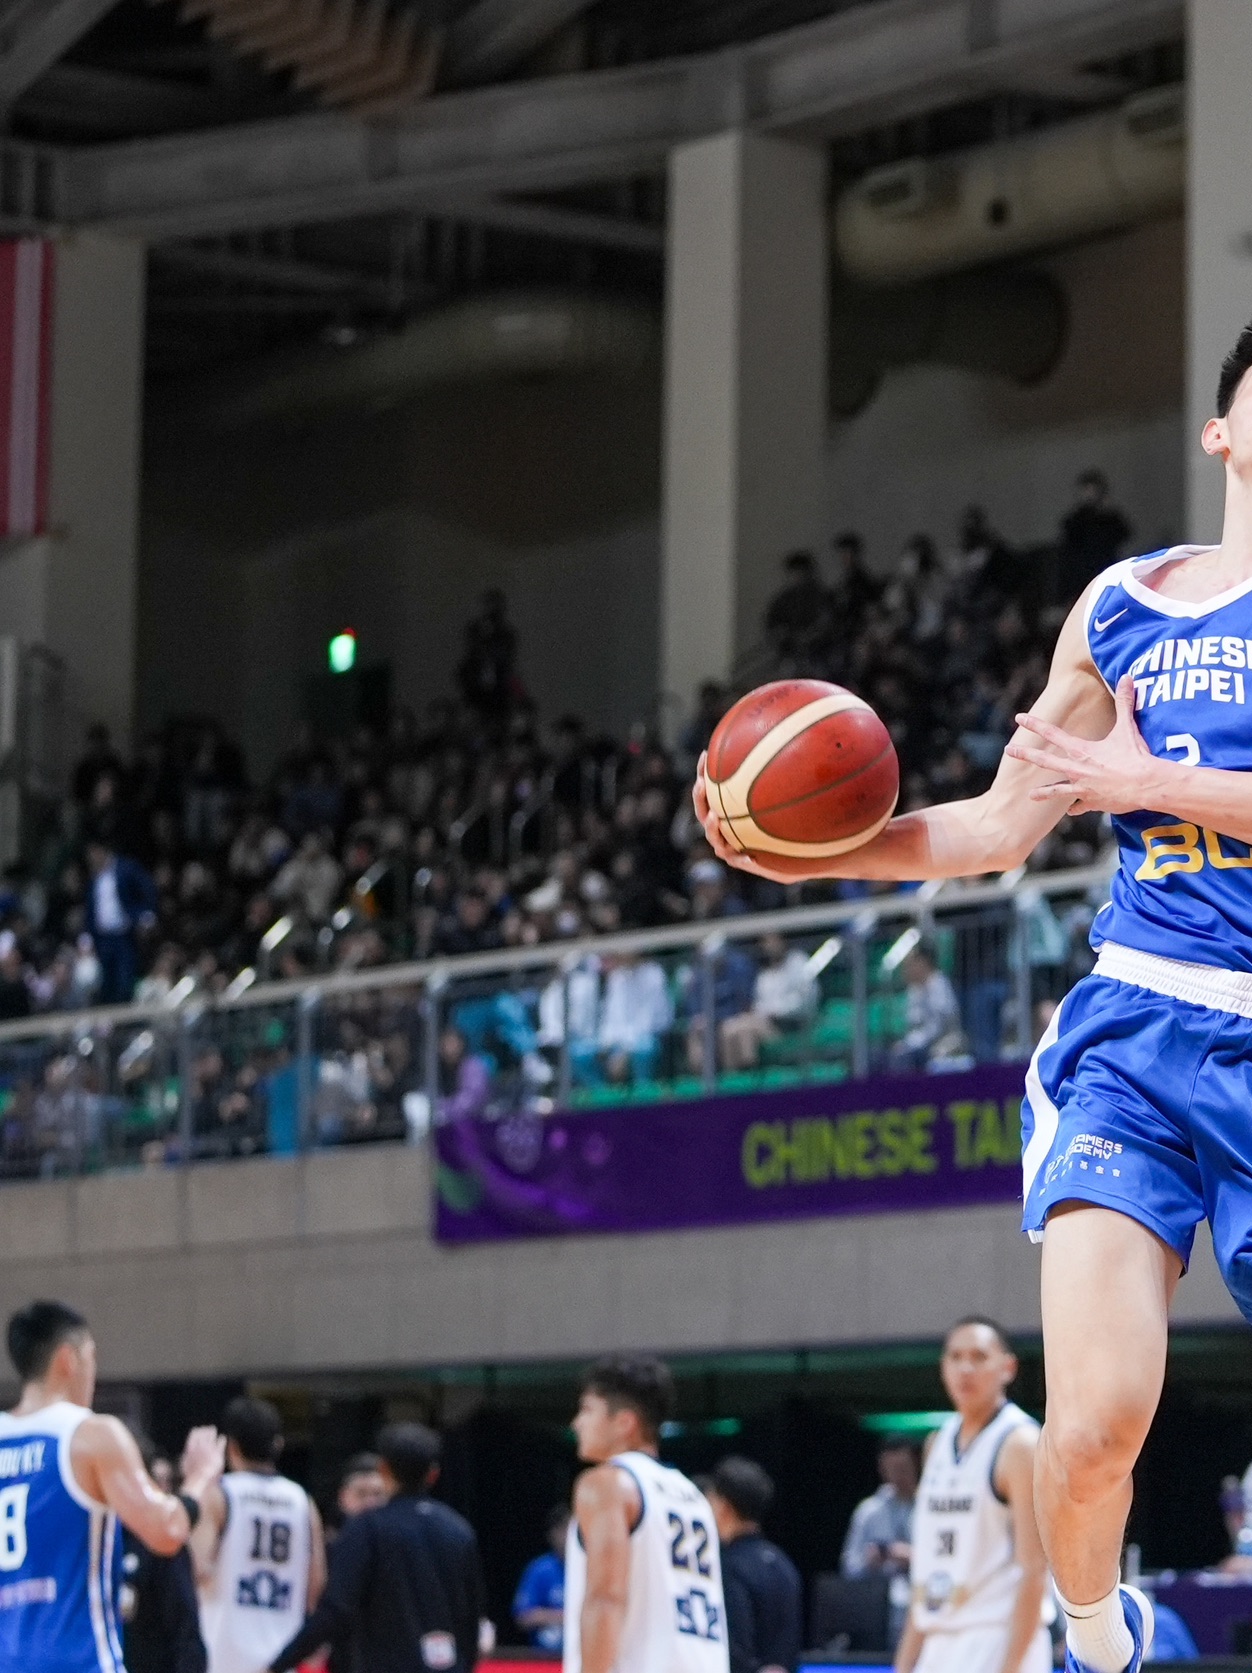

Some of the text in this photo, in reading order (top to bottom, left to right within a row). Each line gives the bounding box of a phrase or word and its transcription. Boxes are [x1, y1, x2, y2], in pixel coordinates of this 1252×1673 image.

[1133, 668, 1245, 711] TAIPEI
[742, 1104, 937, 1190] CHINESE
[947, 1099, 1023, 1169] TAI
[249, 1517, 291, 1563] 18
[668, 1511, 712, 1578] 22
